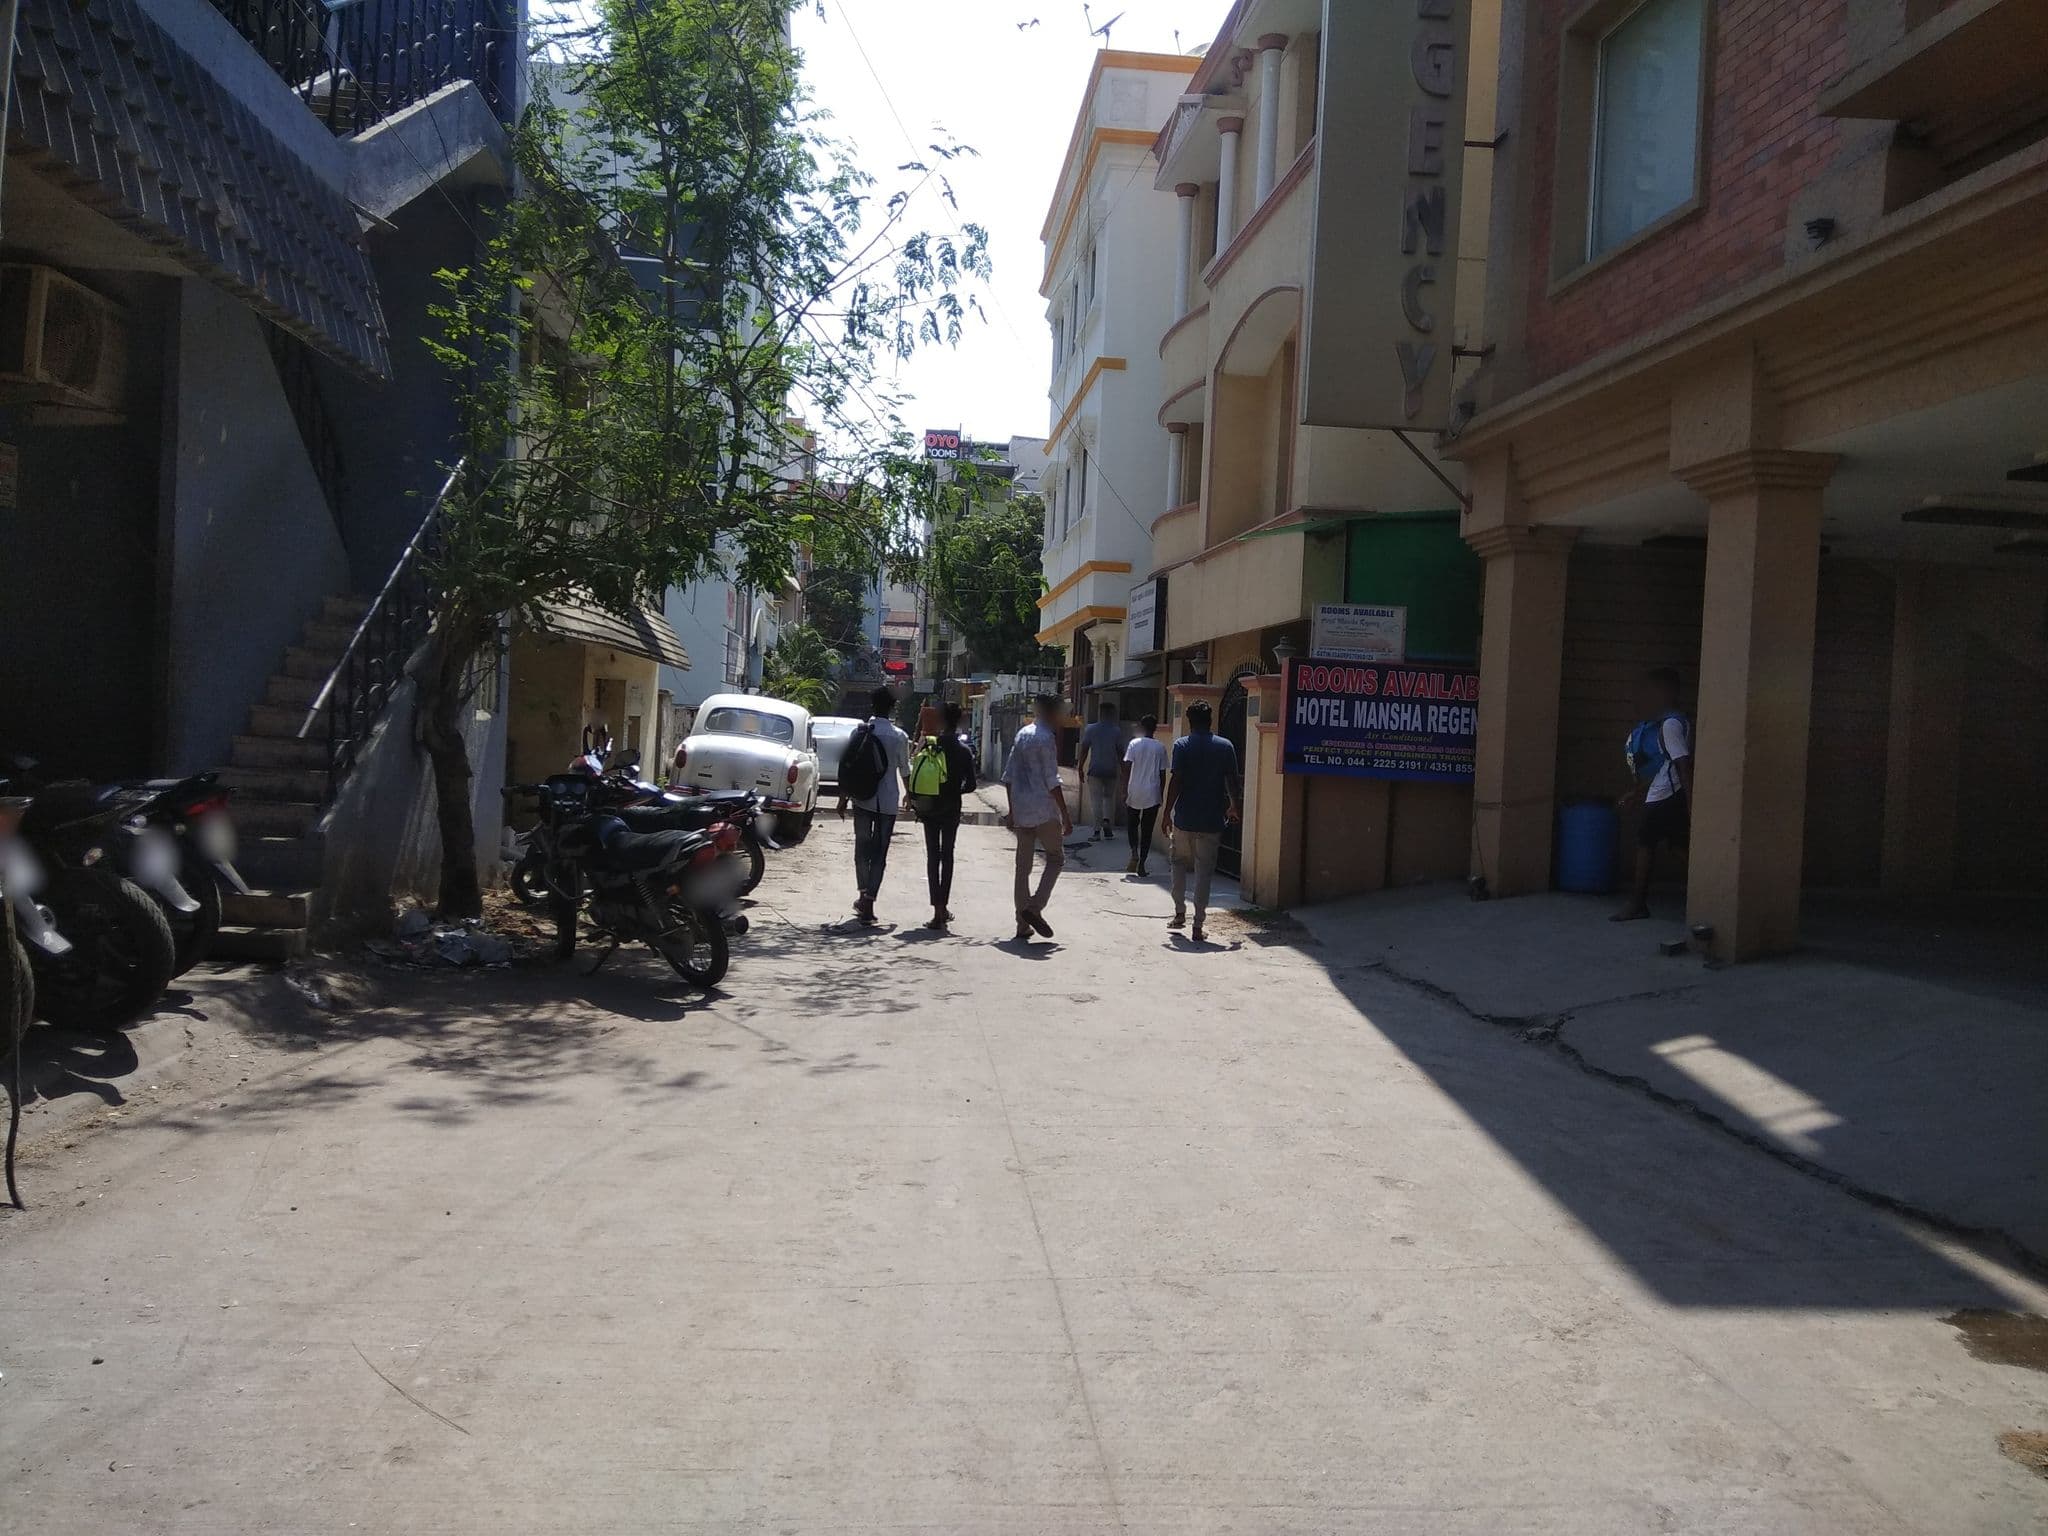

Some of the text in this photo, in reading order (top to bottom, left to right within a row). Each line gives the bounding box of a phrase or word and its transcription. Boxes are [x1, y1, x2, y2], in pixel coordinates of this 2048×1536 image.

[925, 433, 959, 448] OYO
[1321, 606, 1395, 618] ROOMS AVAILABLE
[1297, 665, 1379, 695] ROOMS
[1295, 697, 1349, 727] HOTEL
[1353, 701, 1423, 732] MANSHA
[1303, 745, 1342, 754] PERFECT
[1344, 748, 1373, 757] SPACE
[1374, 750, 1392, 758] FOR
[1303, 754, 1325, 764] TEL.
[1327, 755, 1345, 766] NO.
[1347, 757, 1365, 767] 044
[1373, 758, 1397, 768] 2225
[1399, 760, 1421, 770] 2191
[1430, 762, 1453, 772] 4351
